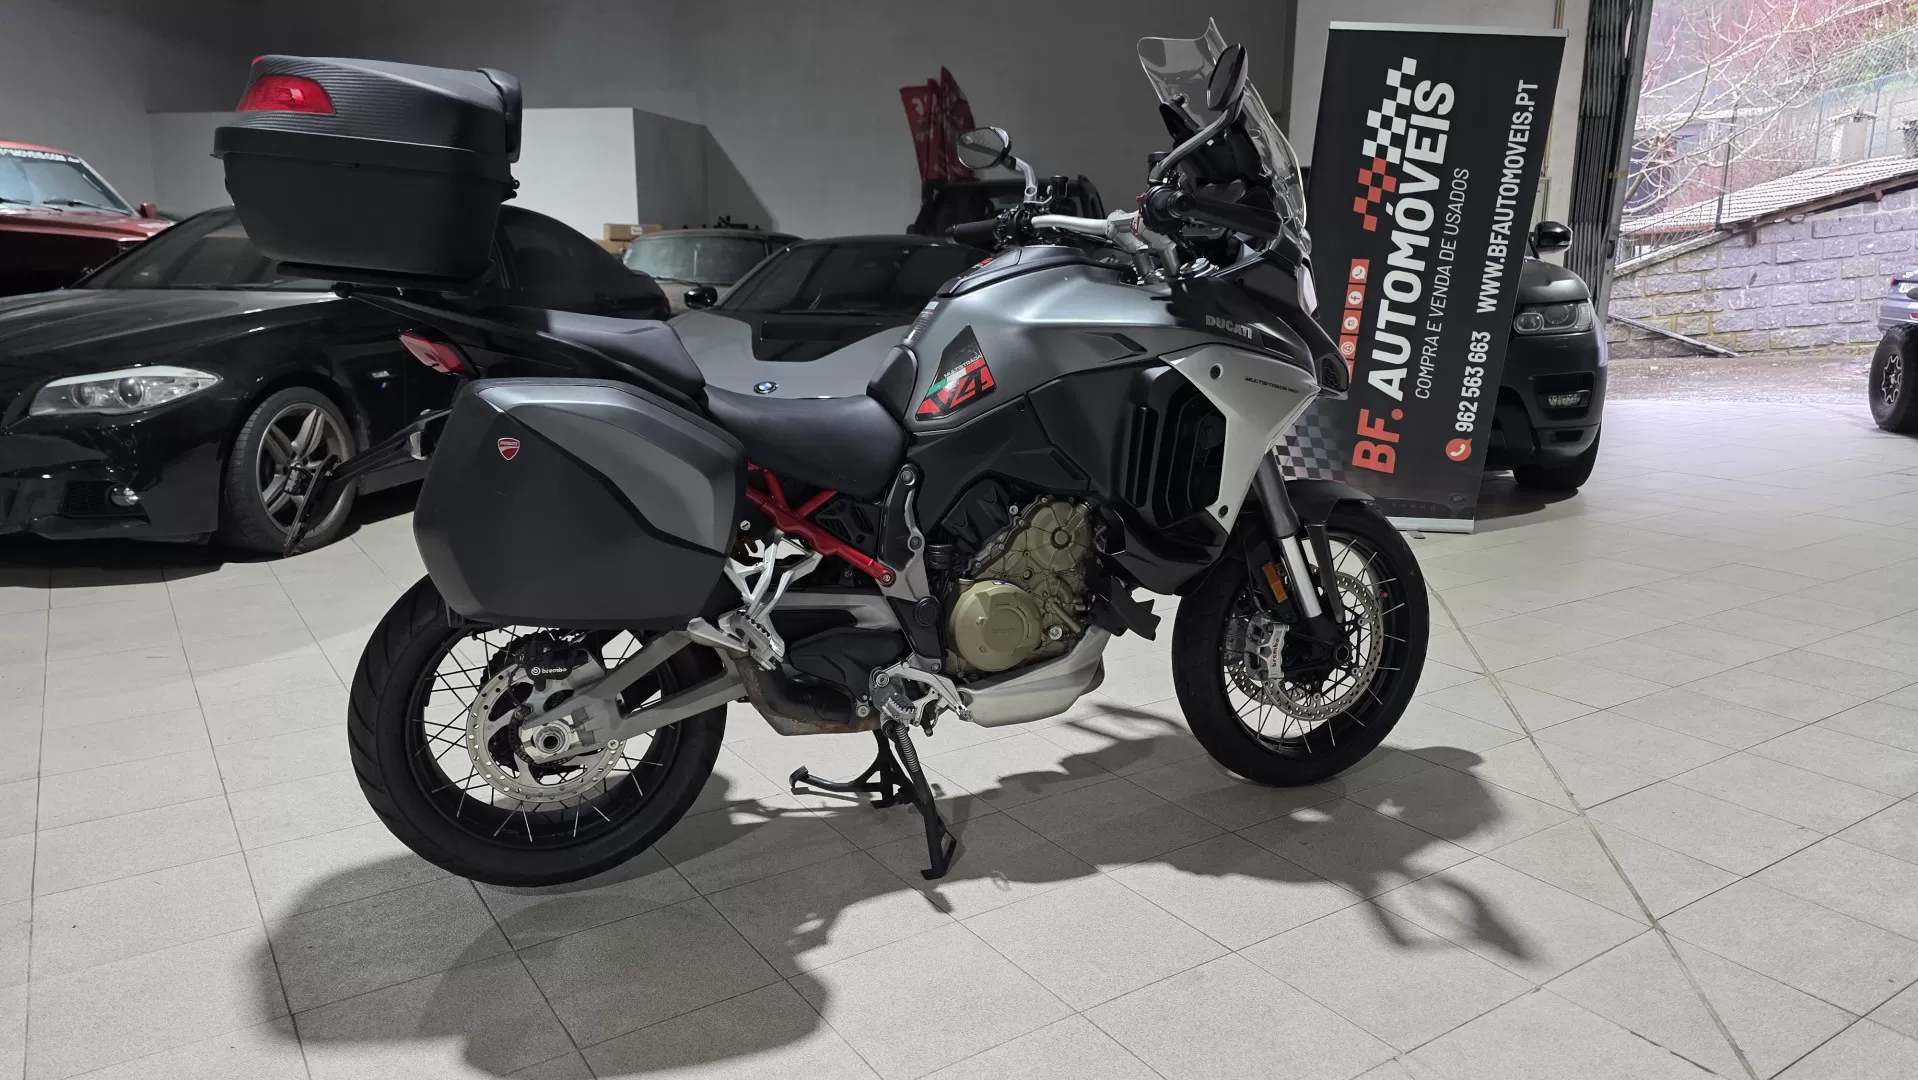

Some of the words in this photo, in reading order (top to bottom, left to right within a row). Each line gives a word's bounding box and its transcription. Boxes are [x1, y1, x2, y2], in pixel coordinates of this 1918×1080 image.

[1443, 167, 1470, 236] USADOS
[1476, 79, 1539, 314] WWW.BFAUTOMOVEIS.PT
[1367, 79, 1455, 402] AUTOMÓVEIS
[1438, 238, 1457, 262] DE
[1428, 265, 1453, 317] VENDA
[1205, 314, 1253, 340] DUCATI
[1426, 319, 1442, 333] E
[1468, 330, 1491, 363] 663
[1414, 336, 1440, 399] COMPRA
[1461, 366, 1485, 398] 563
[1455, 400, 1479, 432] 962
[1352, 408, 1404, 474] BF.
[1272, 638, 1280, 668] brembo
[541, 666, 568, 674] brembo
